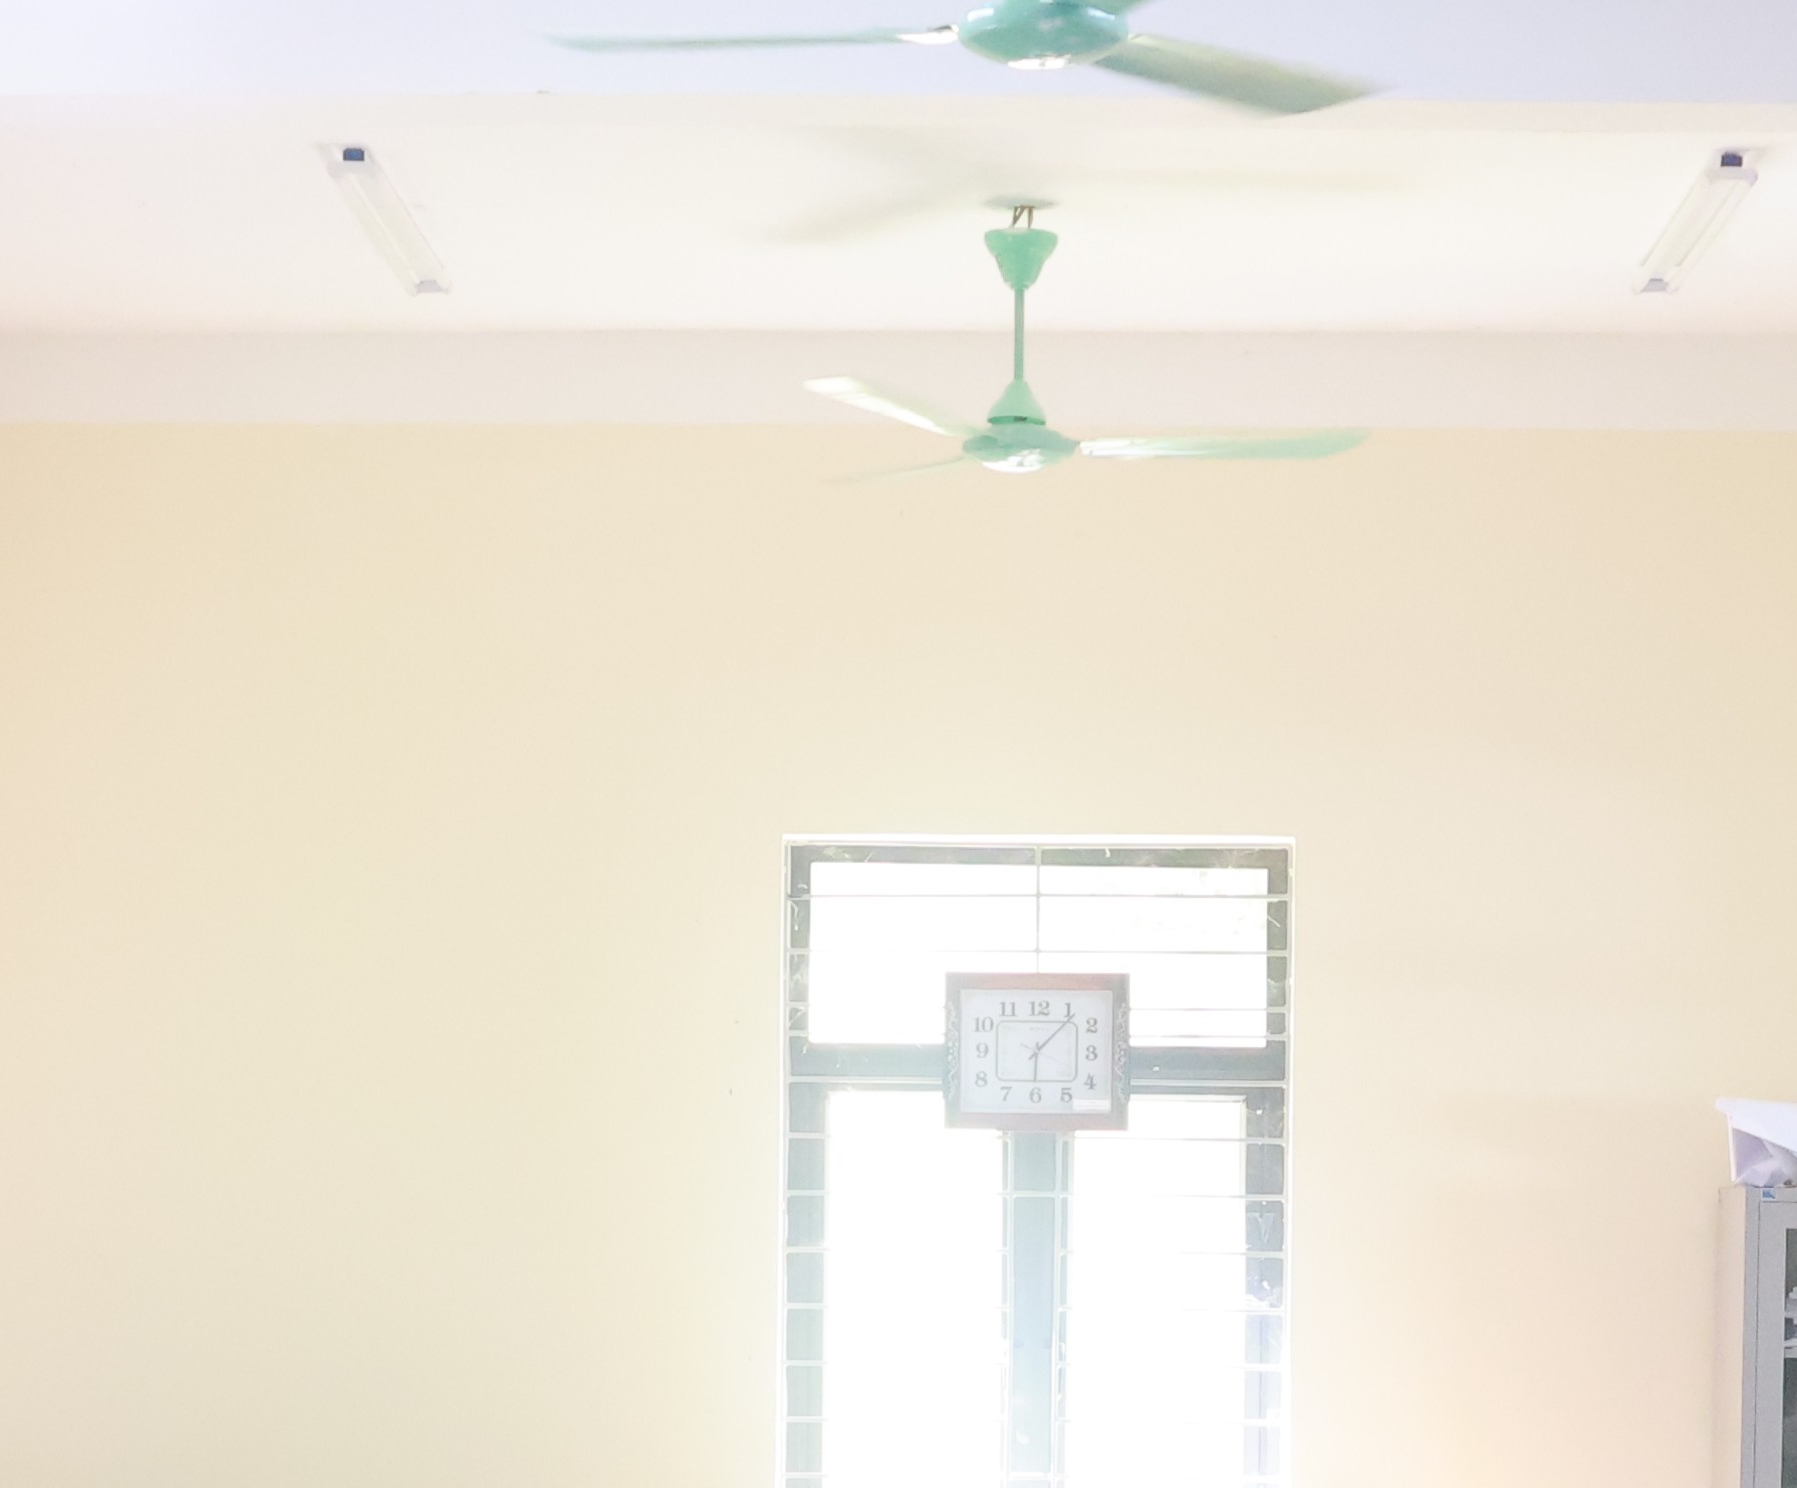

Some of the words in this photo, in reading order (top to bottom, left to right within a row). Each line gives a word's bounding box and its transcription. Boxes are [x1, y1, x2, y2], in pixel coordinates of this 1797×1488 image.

[999, 1001, 1017, 1017] 11
[1028, 1000, 1051, 1017] 12
[973, 1016, 994, 1033] 10
[1085, 1017, 1098, 1034] 2
[975, 1042, 989, 1058] 9
[1085, 1045, 1098, 1061] 3
[974, 1071, 988, 1087] 8
[1083, 1073, 1097, 1090] 4
[1000, 1086, 1014, 1102] 7
[1029, 1087, 1042, 1104] 6
[1060, 1087, 1073, 1103] 5
